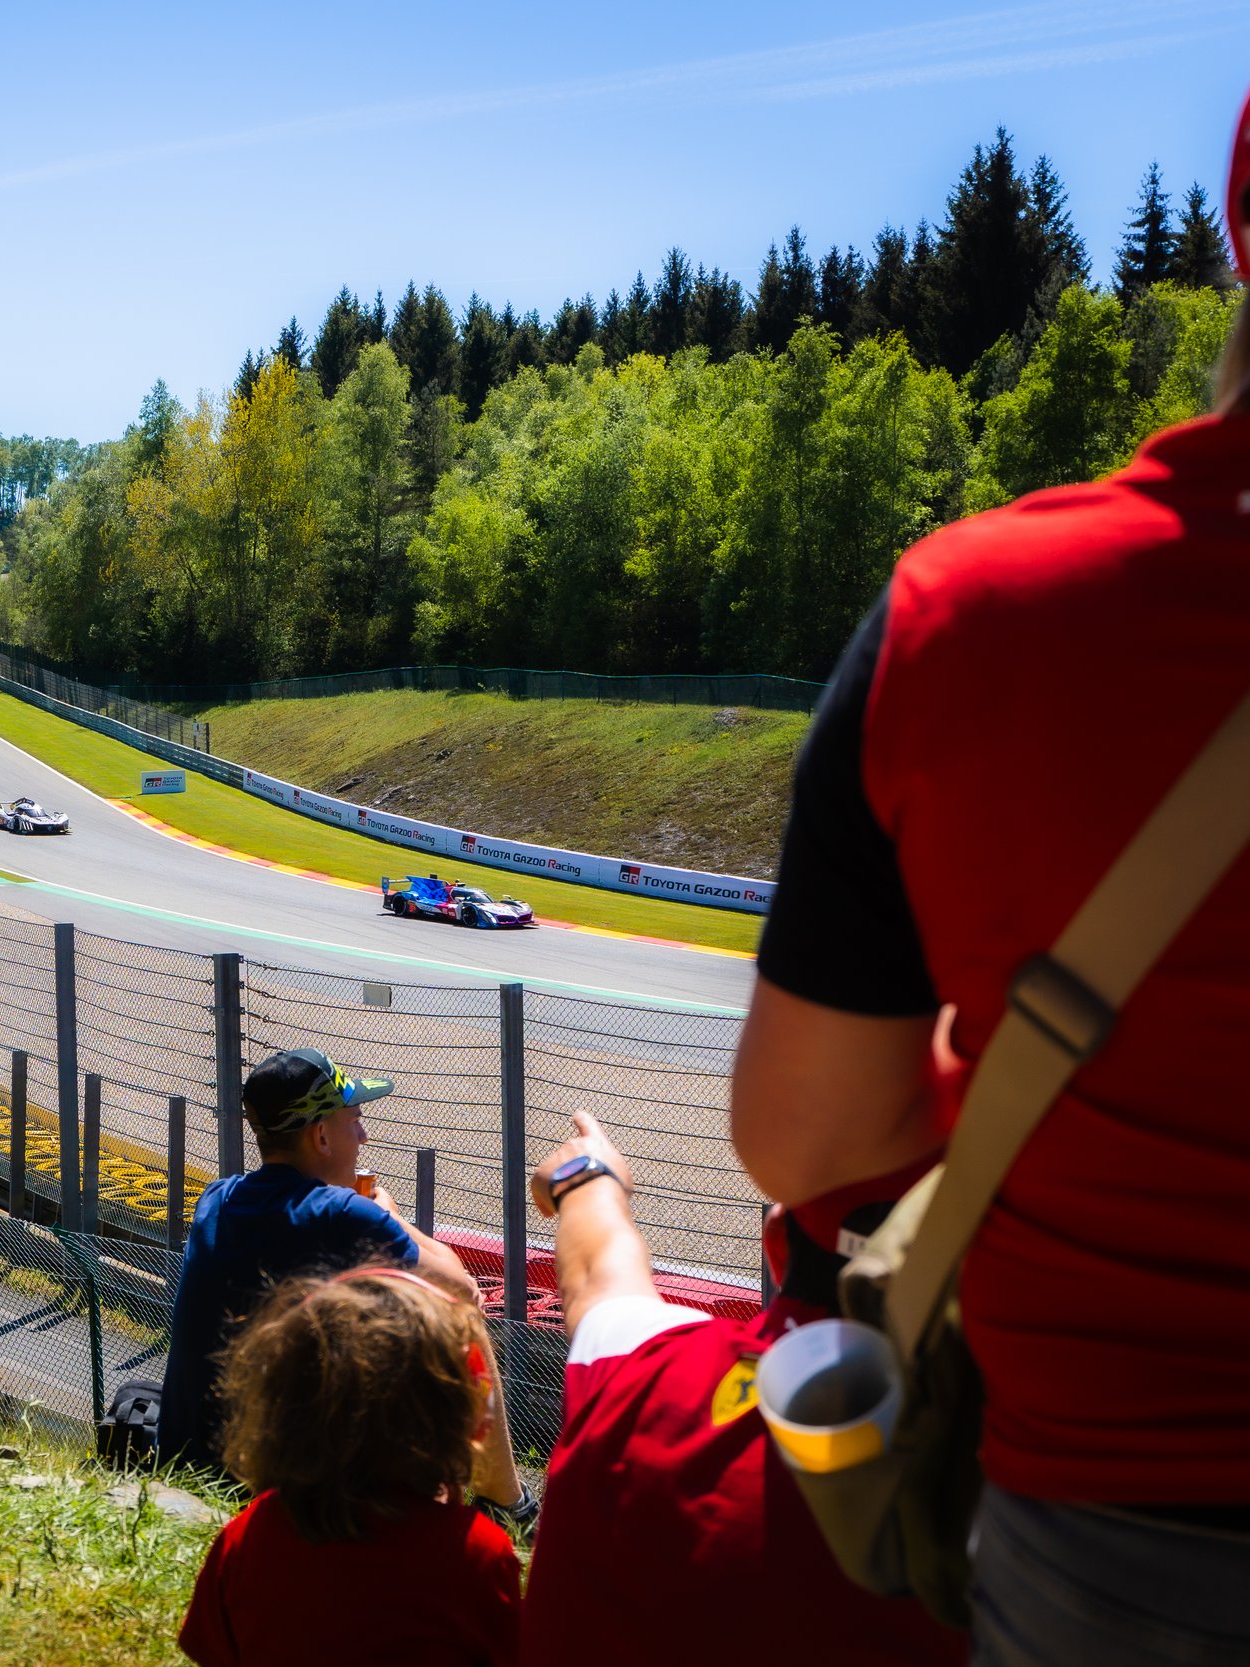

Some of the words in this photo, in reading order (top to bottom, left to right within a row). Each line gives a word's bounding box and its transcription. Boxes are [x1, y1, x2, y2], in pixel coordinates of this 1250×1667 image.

[300, 798, 313, 808] TOYOTA
[314, 803, 328, 814] GAZOO
[328, 807, 342, 820] Racing
[367, 819, 389, 832] TOYOTA
[390, 824, 412, 838] GAZOO
[412, 830, 435, 846] Racing
[477, 845, 511, 861] TOYOTA
[513, 853, 546, 867] GAZOO
[548, 858, 581, 876] Racing
[643, 876, 690, 892] TOYOTA
[694, 884, 740, 899] GAZOO
[744, 890, 771, 903] Rac
